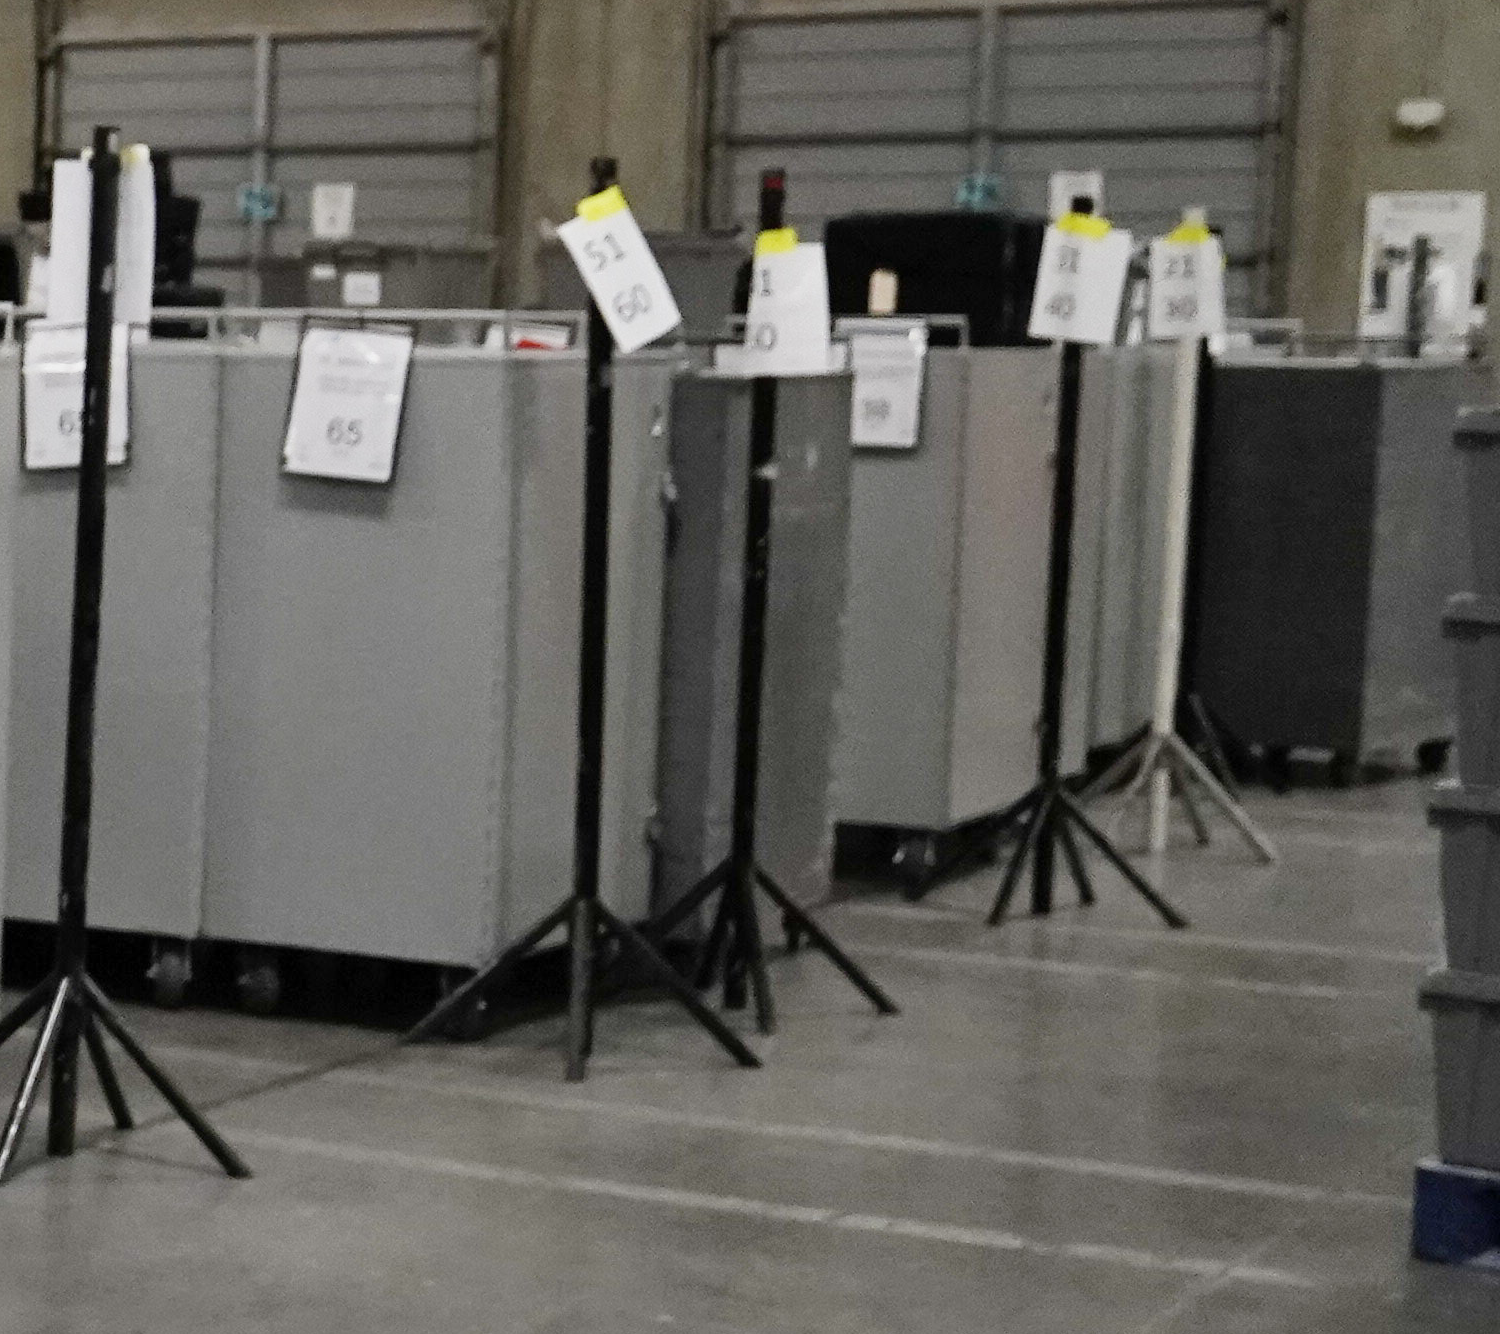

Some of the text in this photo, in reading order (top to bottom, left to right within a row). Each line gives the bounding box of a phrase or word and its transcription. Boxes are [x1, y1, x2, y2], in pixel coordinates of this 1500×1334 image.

[583, 233, 626, 273] 51
[612, 282, 652, 323] 60
[326, 416, 363, 447] 65
